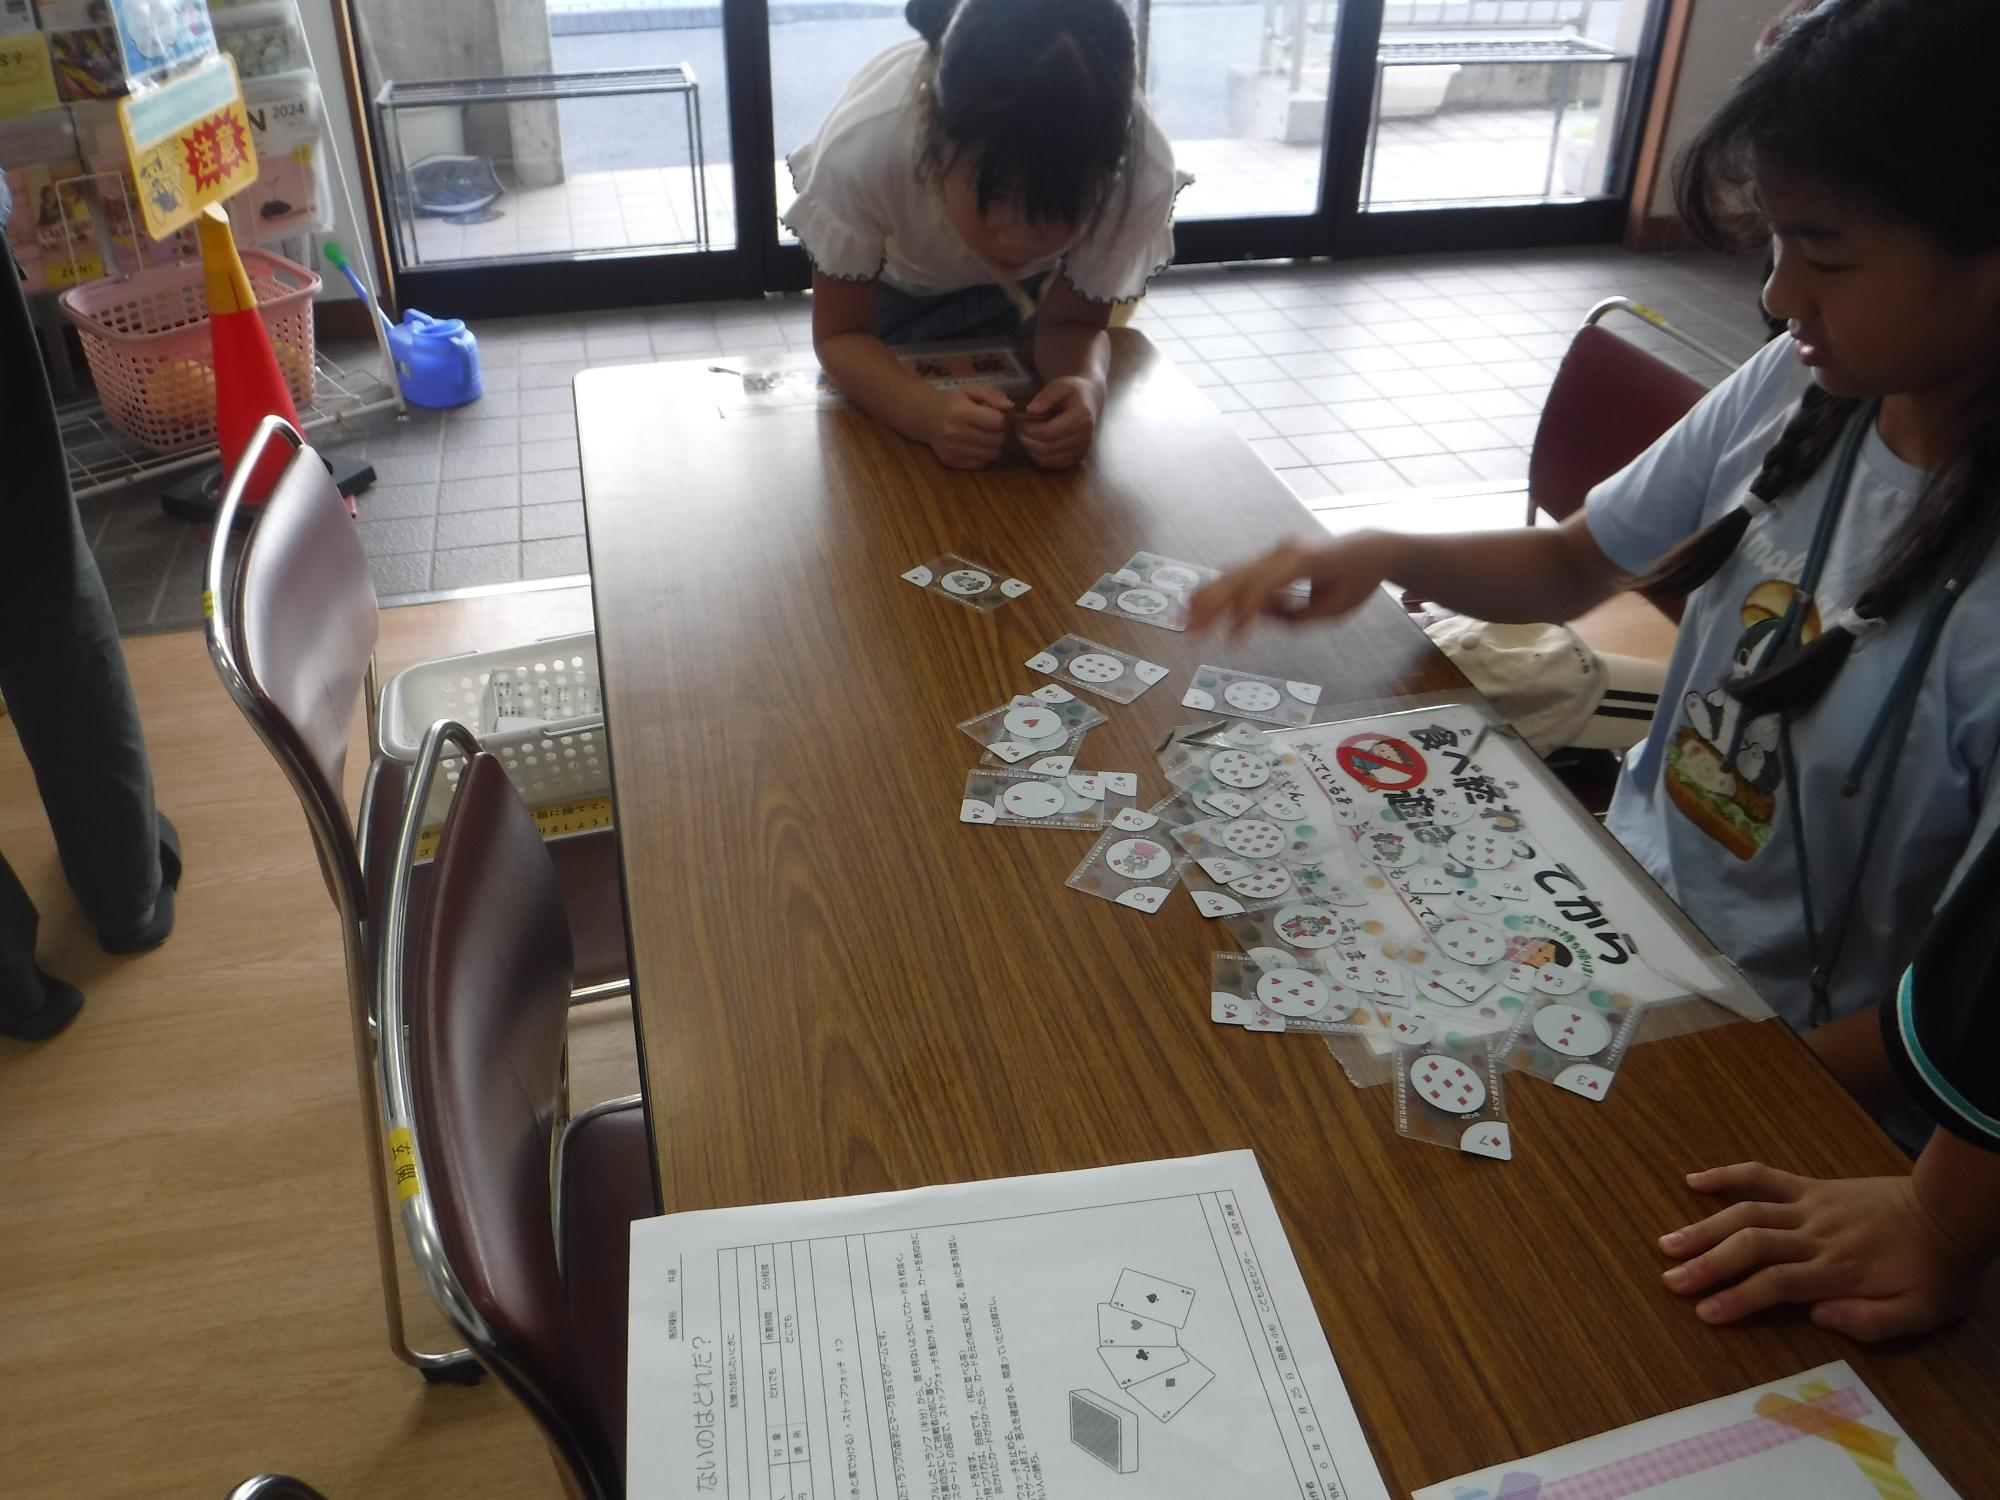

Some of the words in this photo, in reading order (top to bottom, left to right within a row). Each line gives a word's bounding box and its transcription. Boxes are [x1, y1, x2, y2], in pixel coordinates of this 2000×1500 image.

[272, 102, 305, 119] 2024
[193, 123, 241, 178] 注意
[1223, 1003, 1238, 1011] 5
[1576, 1074, 1588, 1086] 3
[1479, 1134, 1489, 1147] 7
[667, 1268, 677, 1283] 共通
[1243, 1250, 1271, 1313] こども文化センター
[763, 1311, 774, 1341] 所要時間
[783, 1314, 794, 1344] どこでも
[727, 1333, 739, 1408] 記憶力を試したいときに
[767, 1367, 779, 1399] だれでも
[1290, 1387, 1303, 1399] 25
[691, 1335, 718, 1492] ないのはどれだ？
[1305, 1424, 1315, 1432] 9
